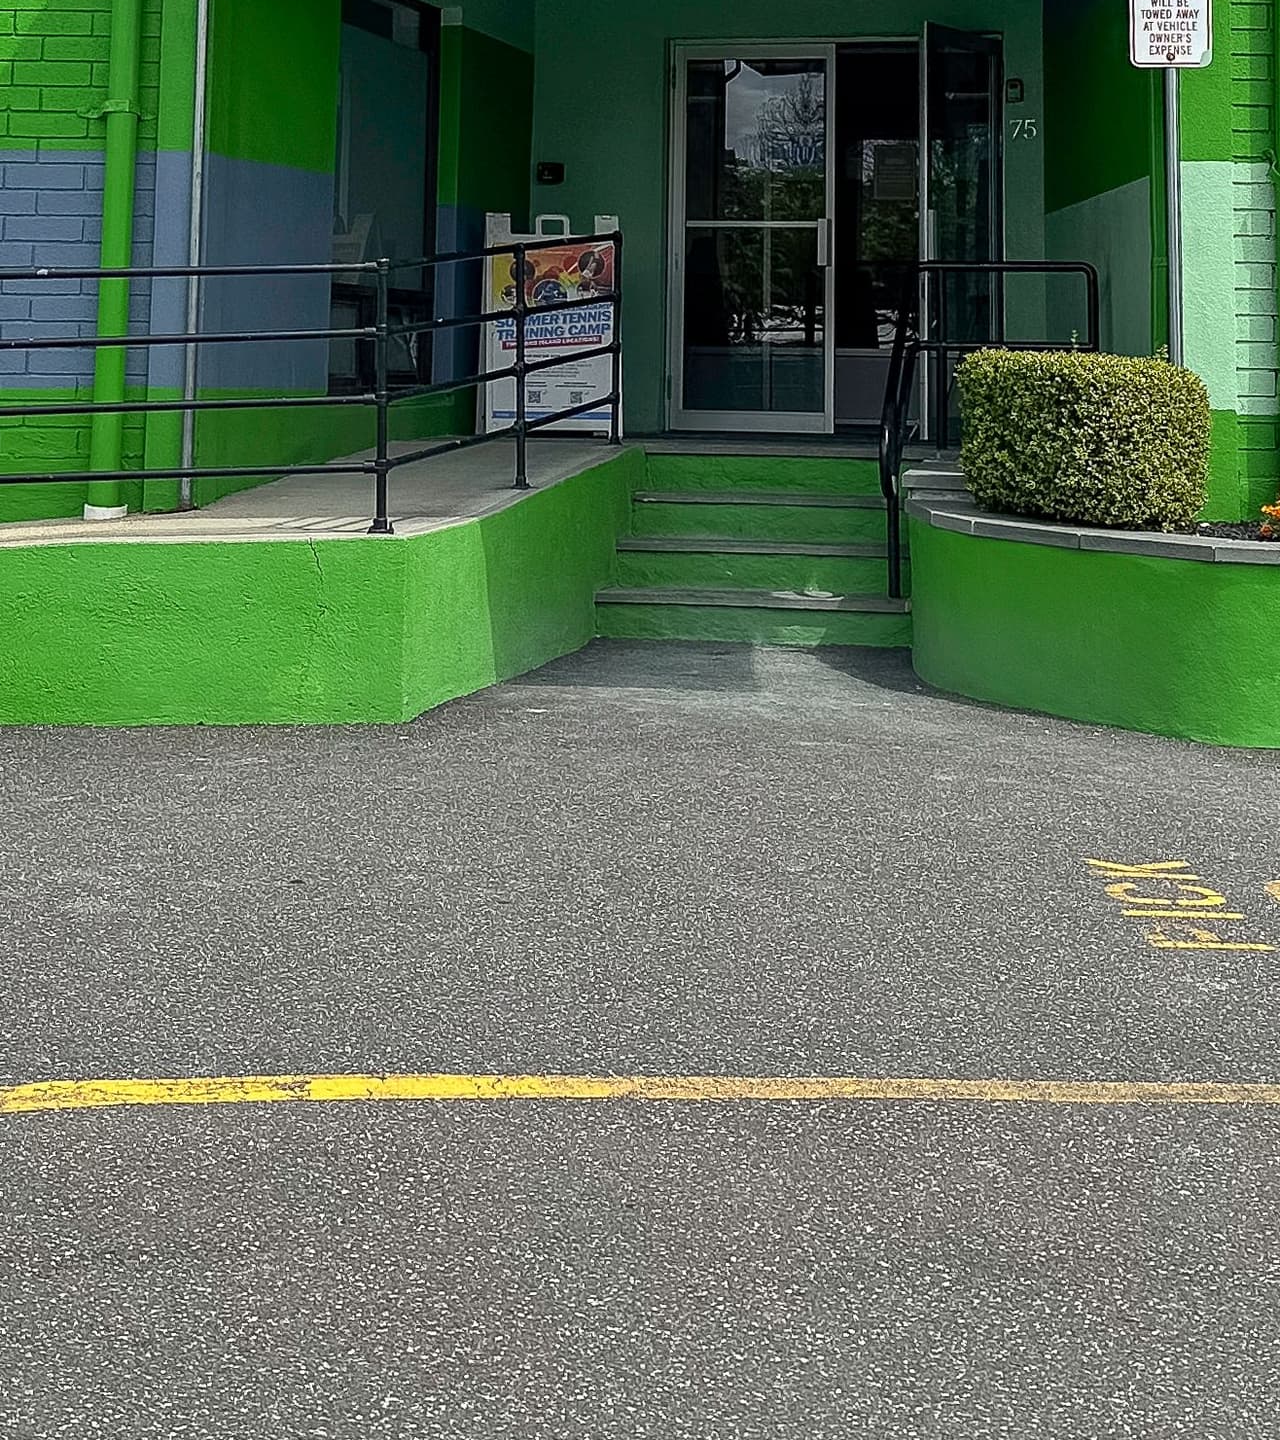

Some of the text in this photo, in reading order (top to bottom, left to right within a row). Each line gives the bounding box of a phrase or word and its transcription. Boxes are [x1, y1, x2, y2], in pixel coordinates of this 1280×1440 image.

[1140, 9, 1200, 20] TOWED AWAY
[1143, 21, 1198, 32] AT VEHICLE
[1149, 33, 1192, 44] OWNER'S
[1149, 45, 1193, 56] EXPENSE
[1009, 119, 1037, 139] 75
[496, 310, 612, 328] SUMER TENNIS
[497, 323, 611, 340] TRINING CAMP
